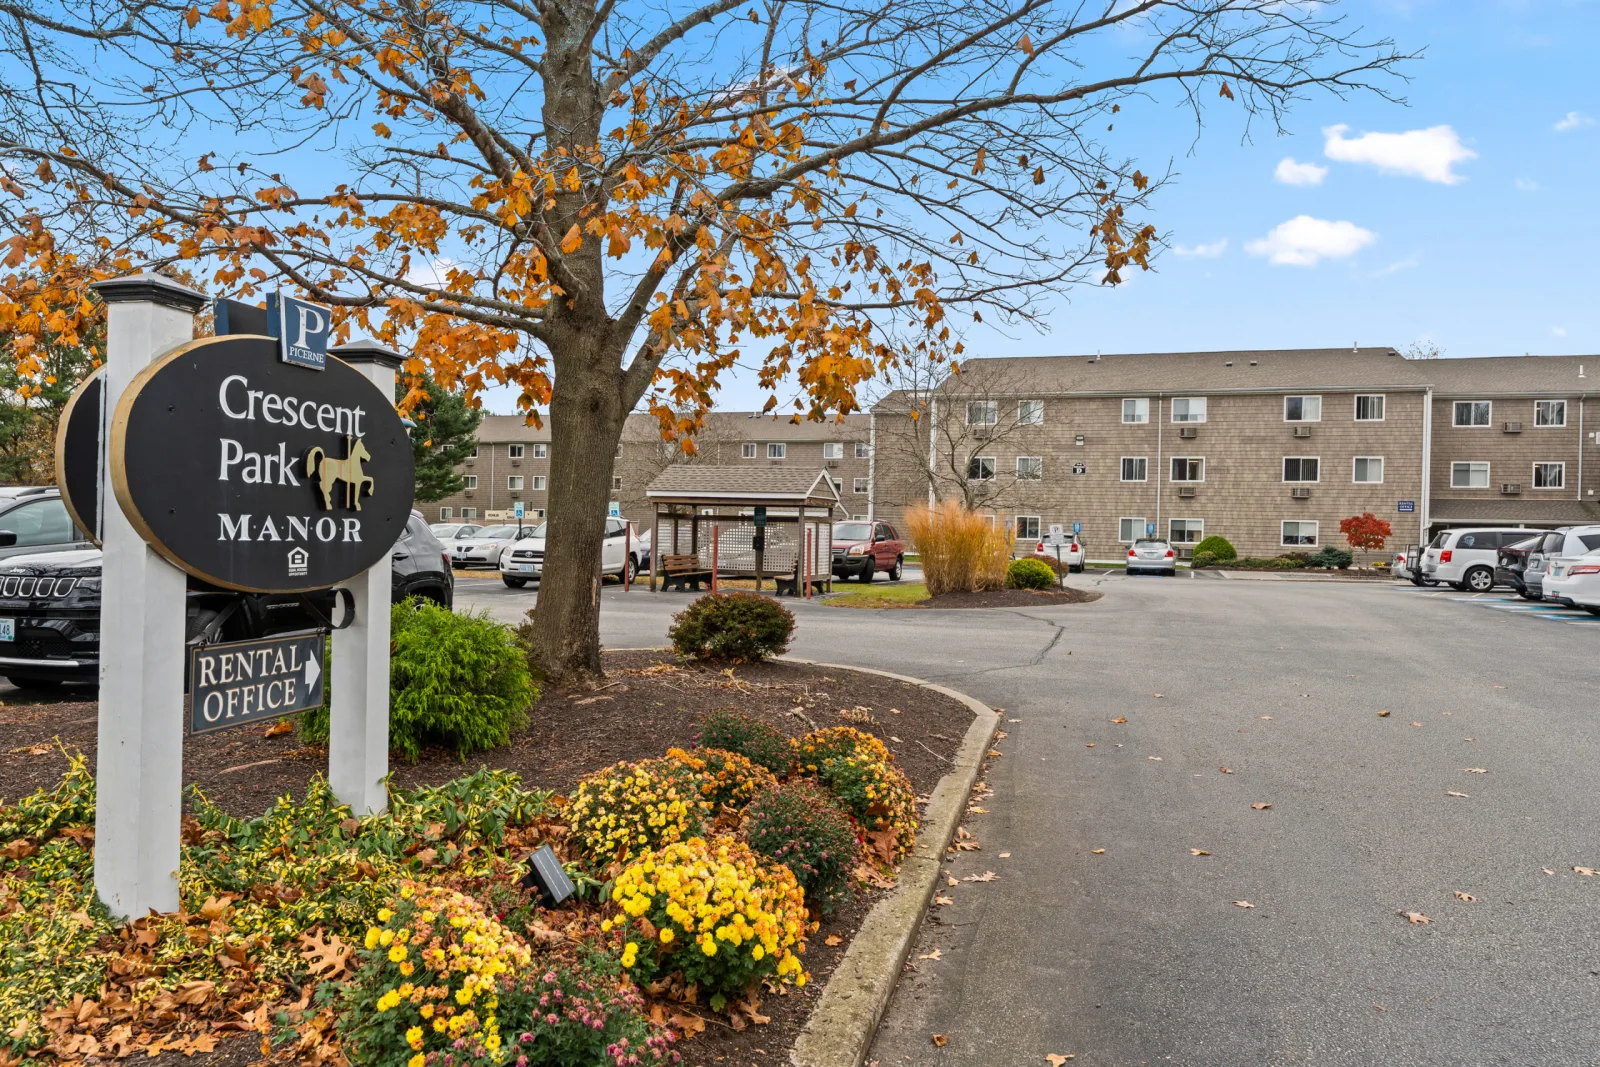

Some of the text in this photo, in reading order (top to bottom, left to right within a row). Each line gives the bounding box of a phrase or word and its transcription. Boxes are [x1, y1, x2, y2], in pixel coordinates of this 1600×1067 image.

[293, 304, 324, 349] P
[289, 346, 325, 363] PICERNE
[219, 374, 366, 438] Crescent
[218, 438, 301, 487] Park
[199, 644, 303, 688] RENTAL
[203, 678, 297, 722] OFFICE
